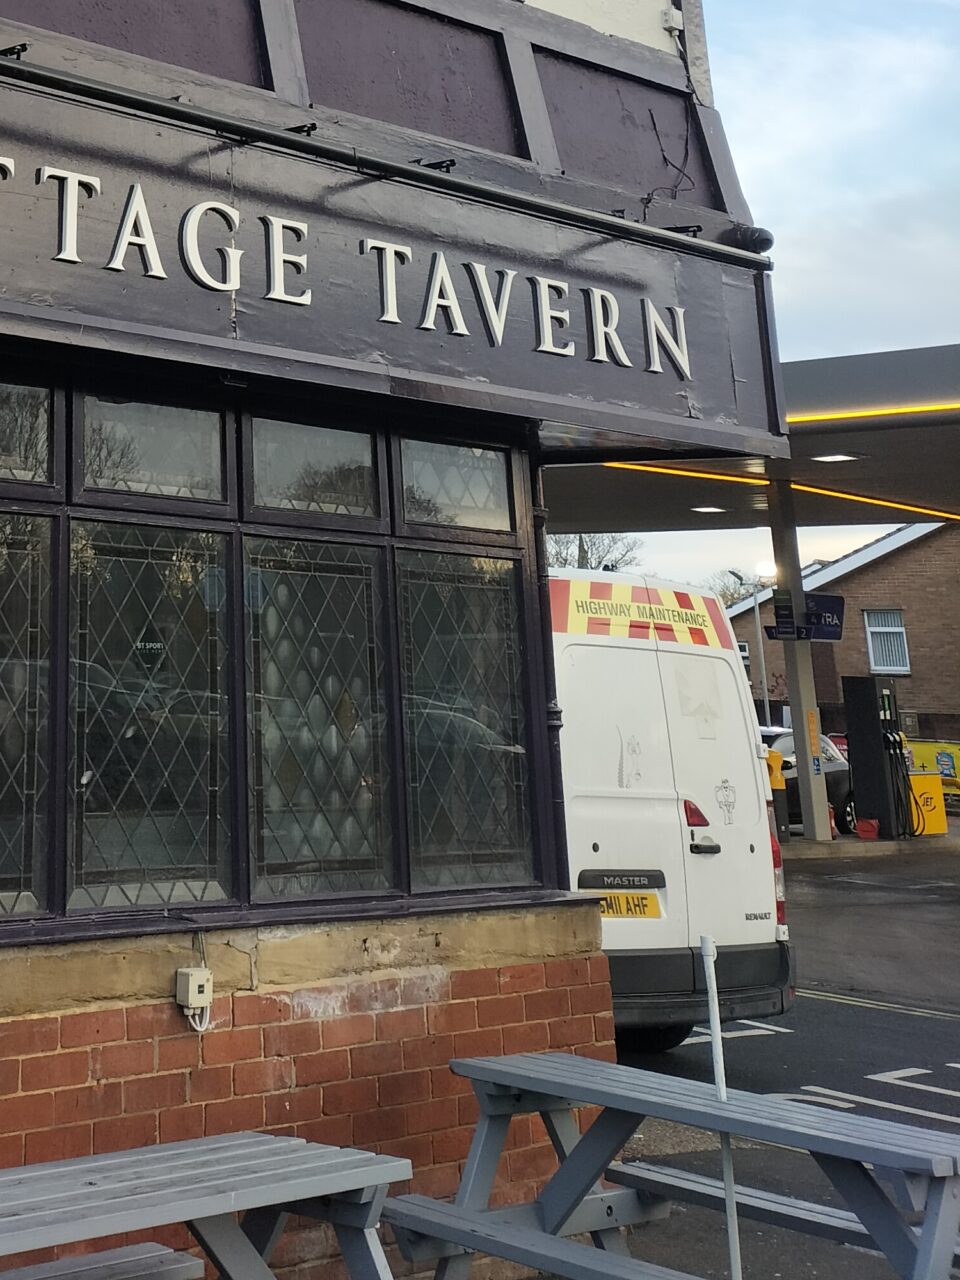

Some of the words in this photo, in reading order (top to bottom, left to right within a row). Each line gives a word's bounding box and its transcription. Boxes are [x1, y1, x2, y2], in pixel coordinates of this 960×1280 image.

[360, 238, 693, 381] TAVERN
[575, 599, 632, 618] HIGHWAY
[636, 604, 709, 628] MAINTENANCE
[800, 629, 807, 637] 2
[922, 796, 934, 808] JET
[603, 876, 649, 886] MASTER
[625, 895, 648, 915] AHF
[745, 912, 771, 921] RENAULT
